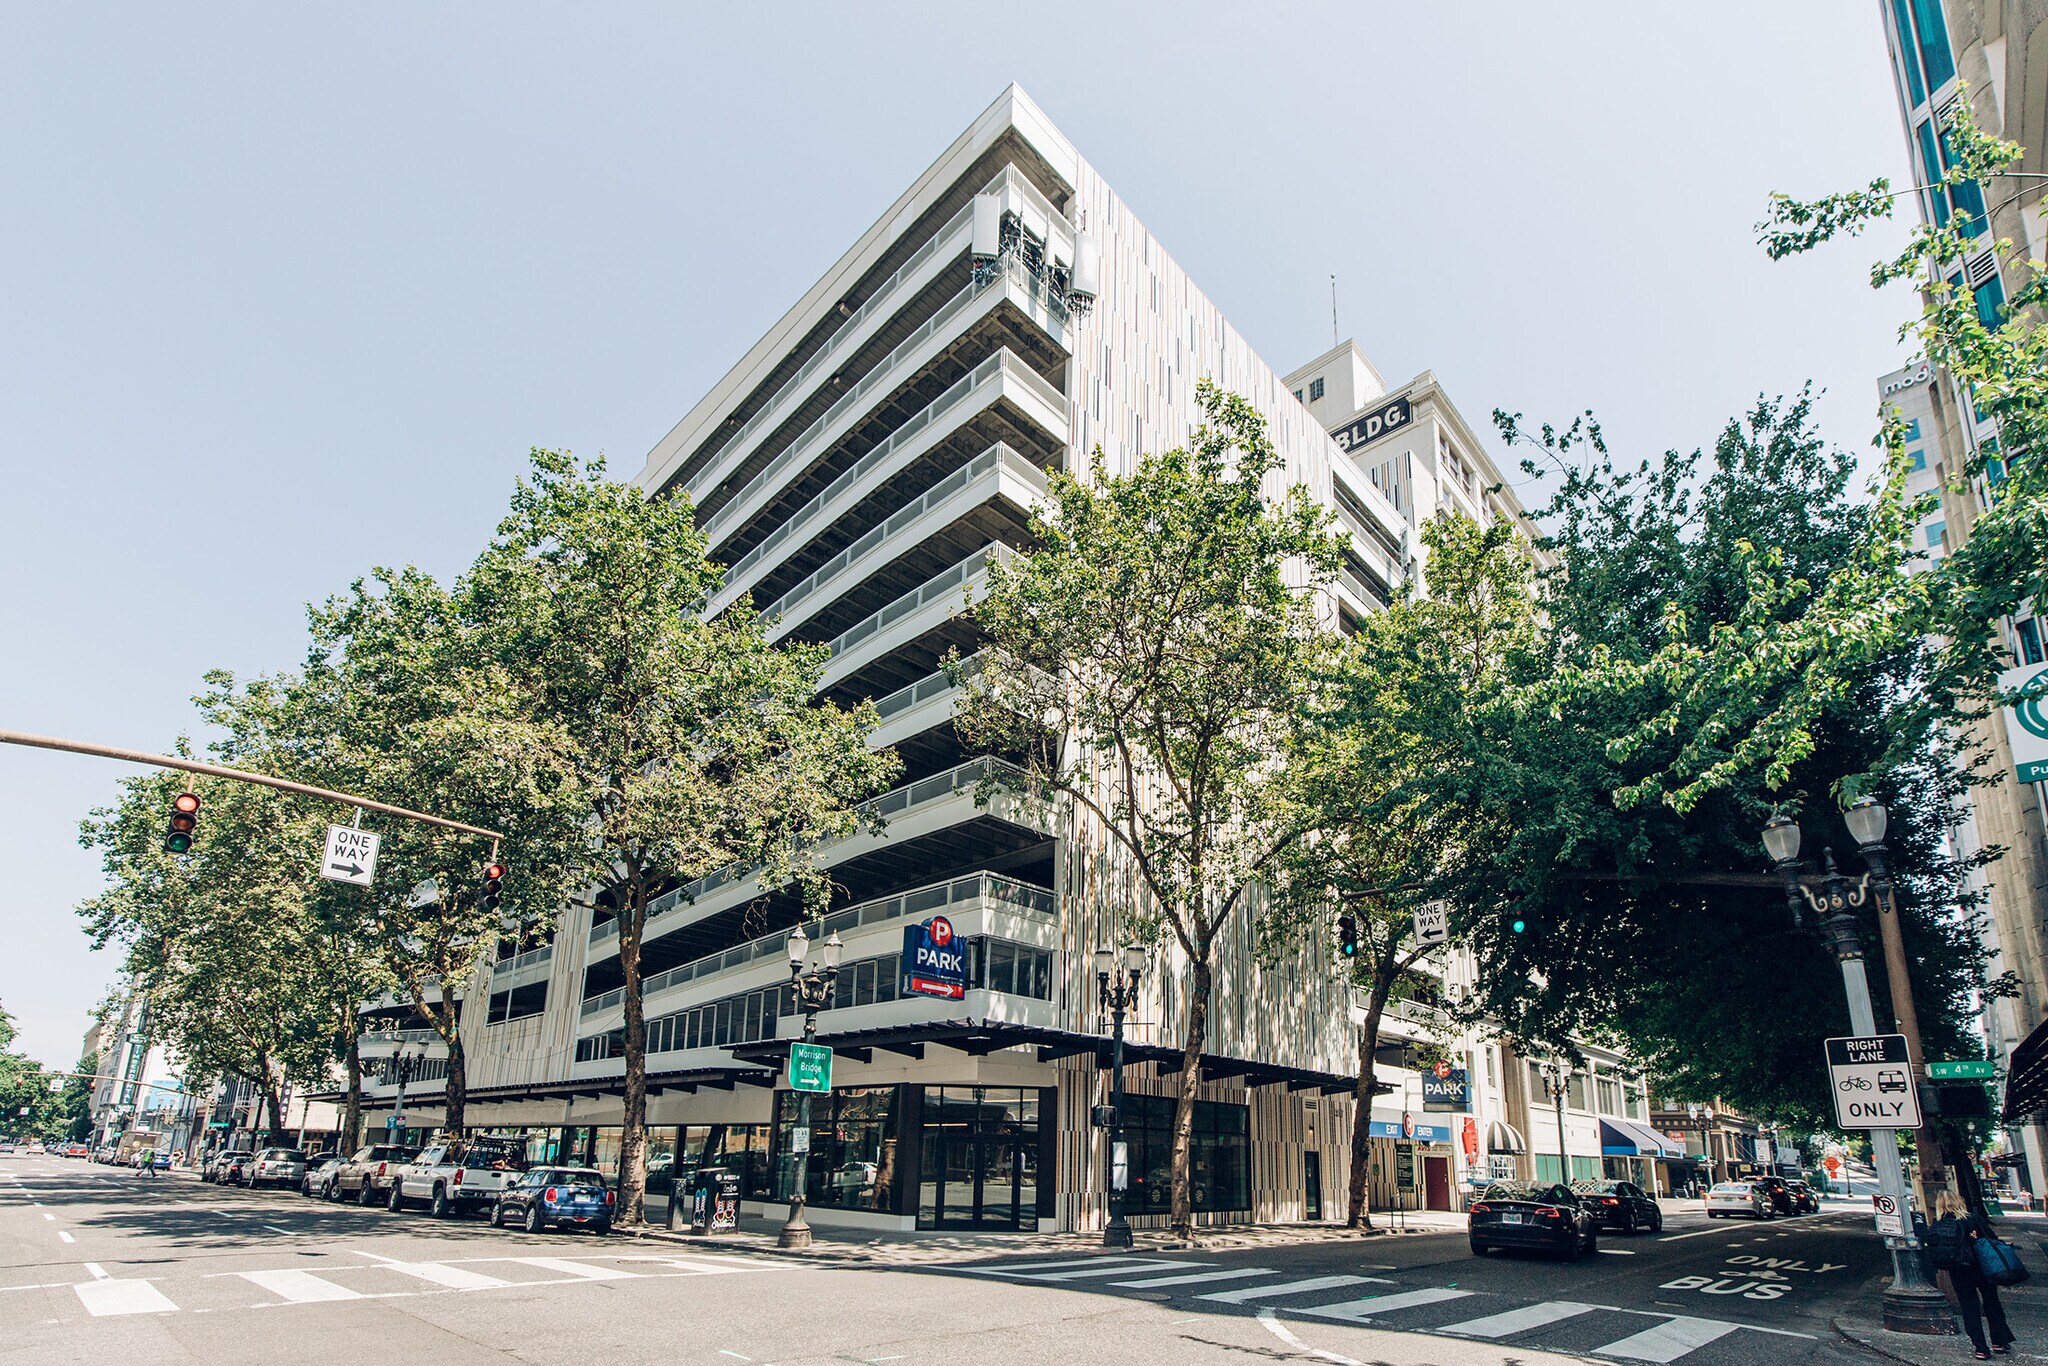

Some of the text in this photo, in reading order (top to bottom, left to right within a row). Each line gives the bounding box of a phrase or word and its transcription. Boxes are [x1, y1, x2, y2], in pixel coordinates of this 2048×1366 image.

[1334, 405, 1406, 451] BLDG.
[338, 831, 371, 849] ONE
[334, 844, 370, 861] WAY
[1418, 903, 1440, 917] ONE
[1418, 914, 1442, 928] WAY
[935, 921, 950, 941] P
[916, 947, 963, 973] PARK
[1846, 1039, 1885, 1052] RIGHT
[798, 1048, 826, 1061] Morrison
[1849, 1050, 1887, 1063] LANE
[800, 1061, 823, 1075] Bridge
[1438, 1063, 1449, 1076] P
[1935, 1067, 1947, 1075] SW
[1954, 1064, 1970, 1074] 4th
[1424, 1083, 1464, 1096] PARK
[1849, 1101, 1904, 1118] ONLY
[1385, 1124, 1398, 1135] EXIT
[1417, 1126, 1434, 1137] ENTER
[1417, 1144, 1431, 1152] AVIS
[1725, 1255, 1848, 1273] ONLY
[1658, 1275, 1793, 1300] BUS
